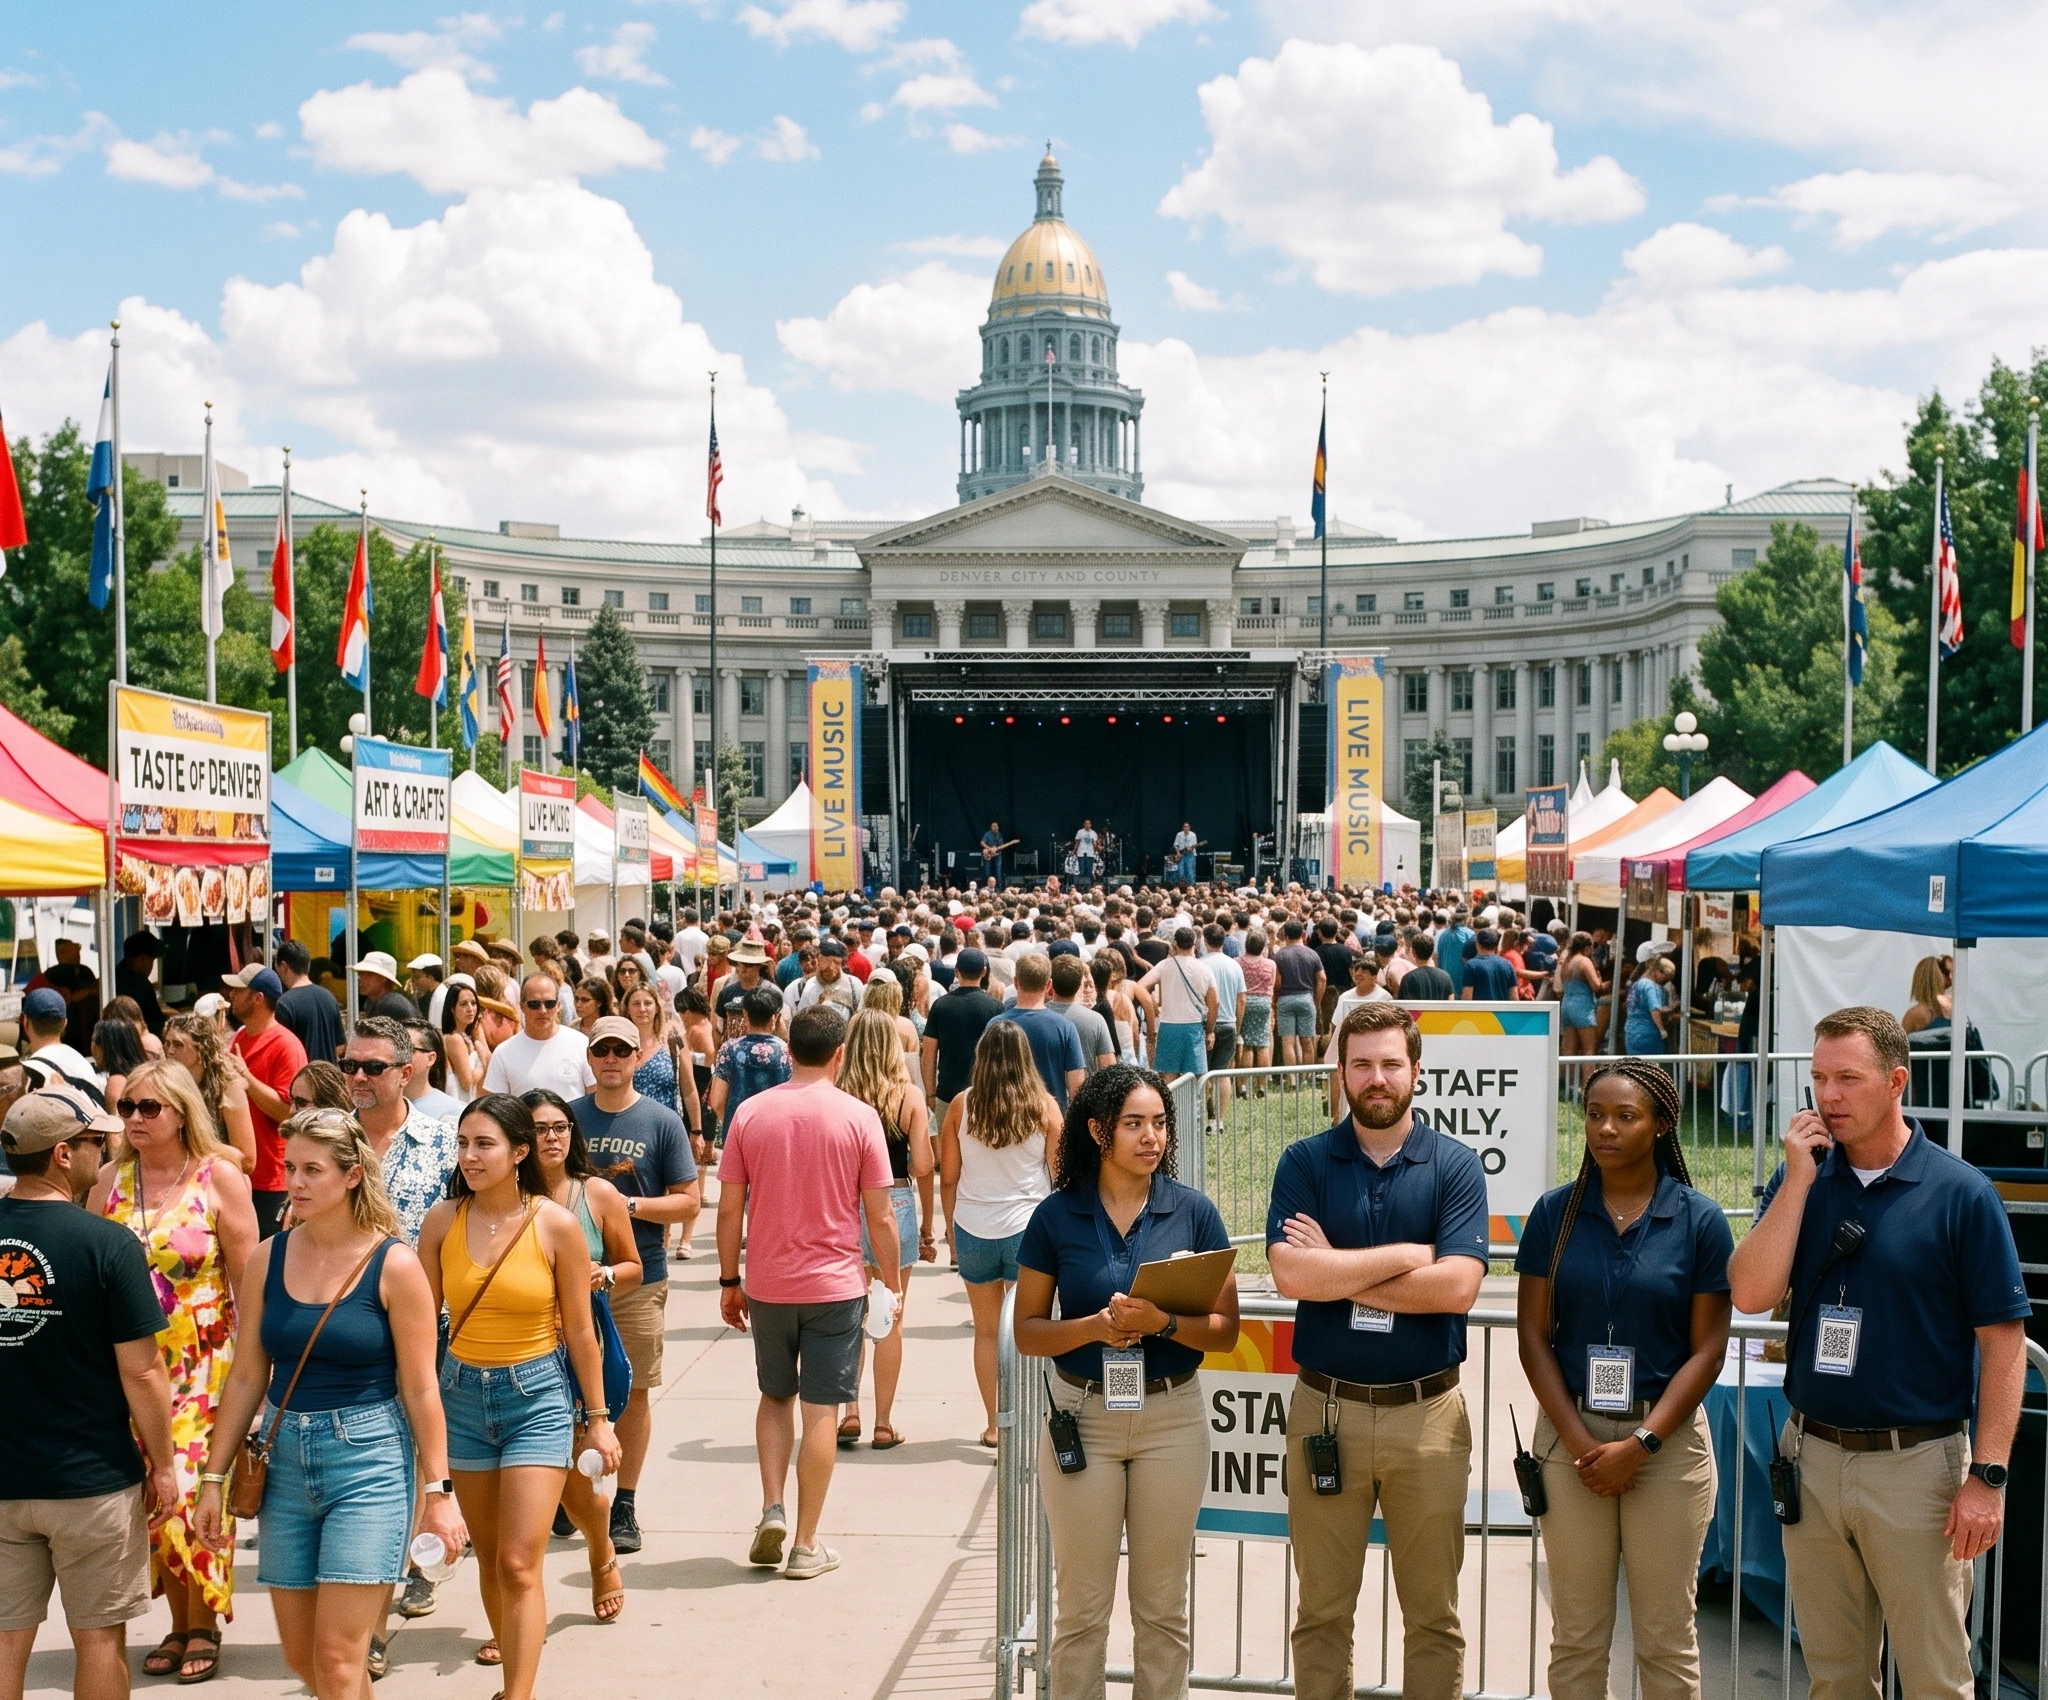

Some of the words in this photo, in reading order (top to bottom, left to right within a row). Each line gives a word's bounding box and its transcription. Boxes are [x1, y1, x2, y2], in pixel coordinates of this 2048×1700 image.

[939, 571, 1002, 582] DENVER
[1011, 571, 1048, 582] CITY
[1055, 571, 1086, 582] AND
[1094, 571, 1161, 582] COUNTY
[822, 701, 844, 789] MUSIC
[1347, 699, 1369, 758] LIVE
[130, 746, 185, 793] TASTE
[189, 760, 205, 791] OF
[208, 758, 262, 800] DENVER
[364, 779, 390, 817] ART
[392, 783, 401, 819] &
[404, 784, 445, 821] CRAFTS
[528, 802, 548, 832] LIVE
[823, 798, 846, 857] LIVE
[1347, 768, 1370, 856] MUSIC
[1210, 1389, 1295, 1436] STA
